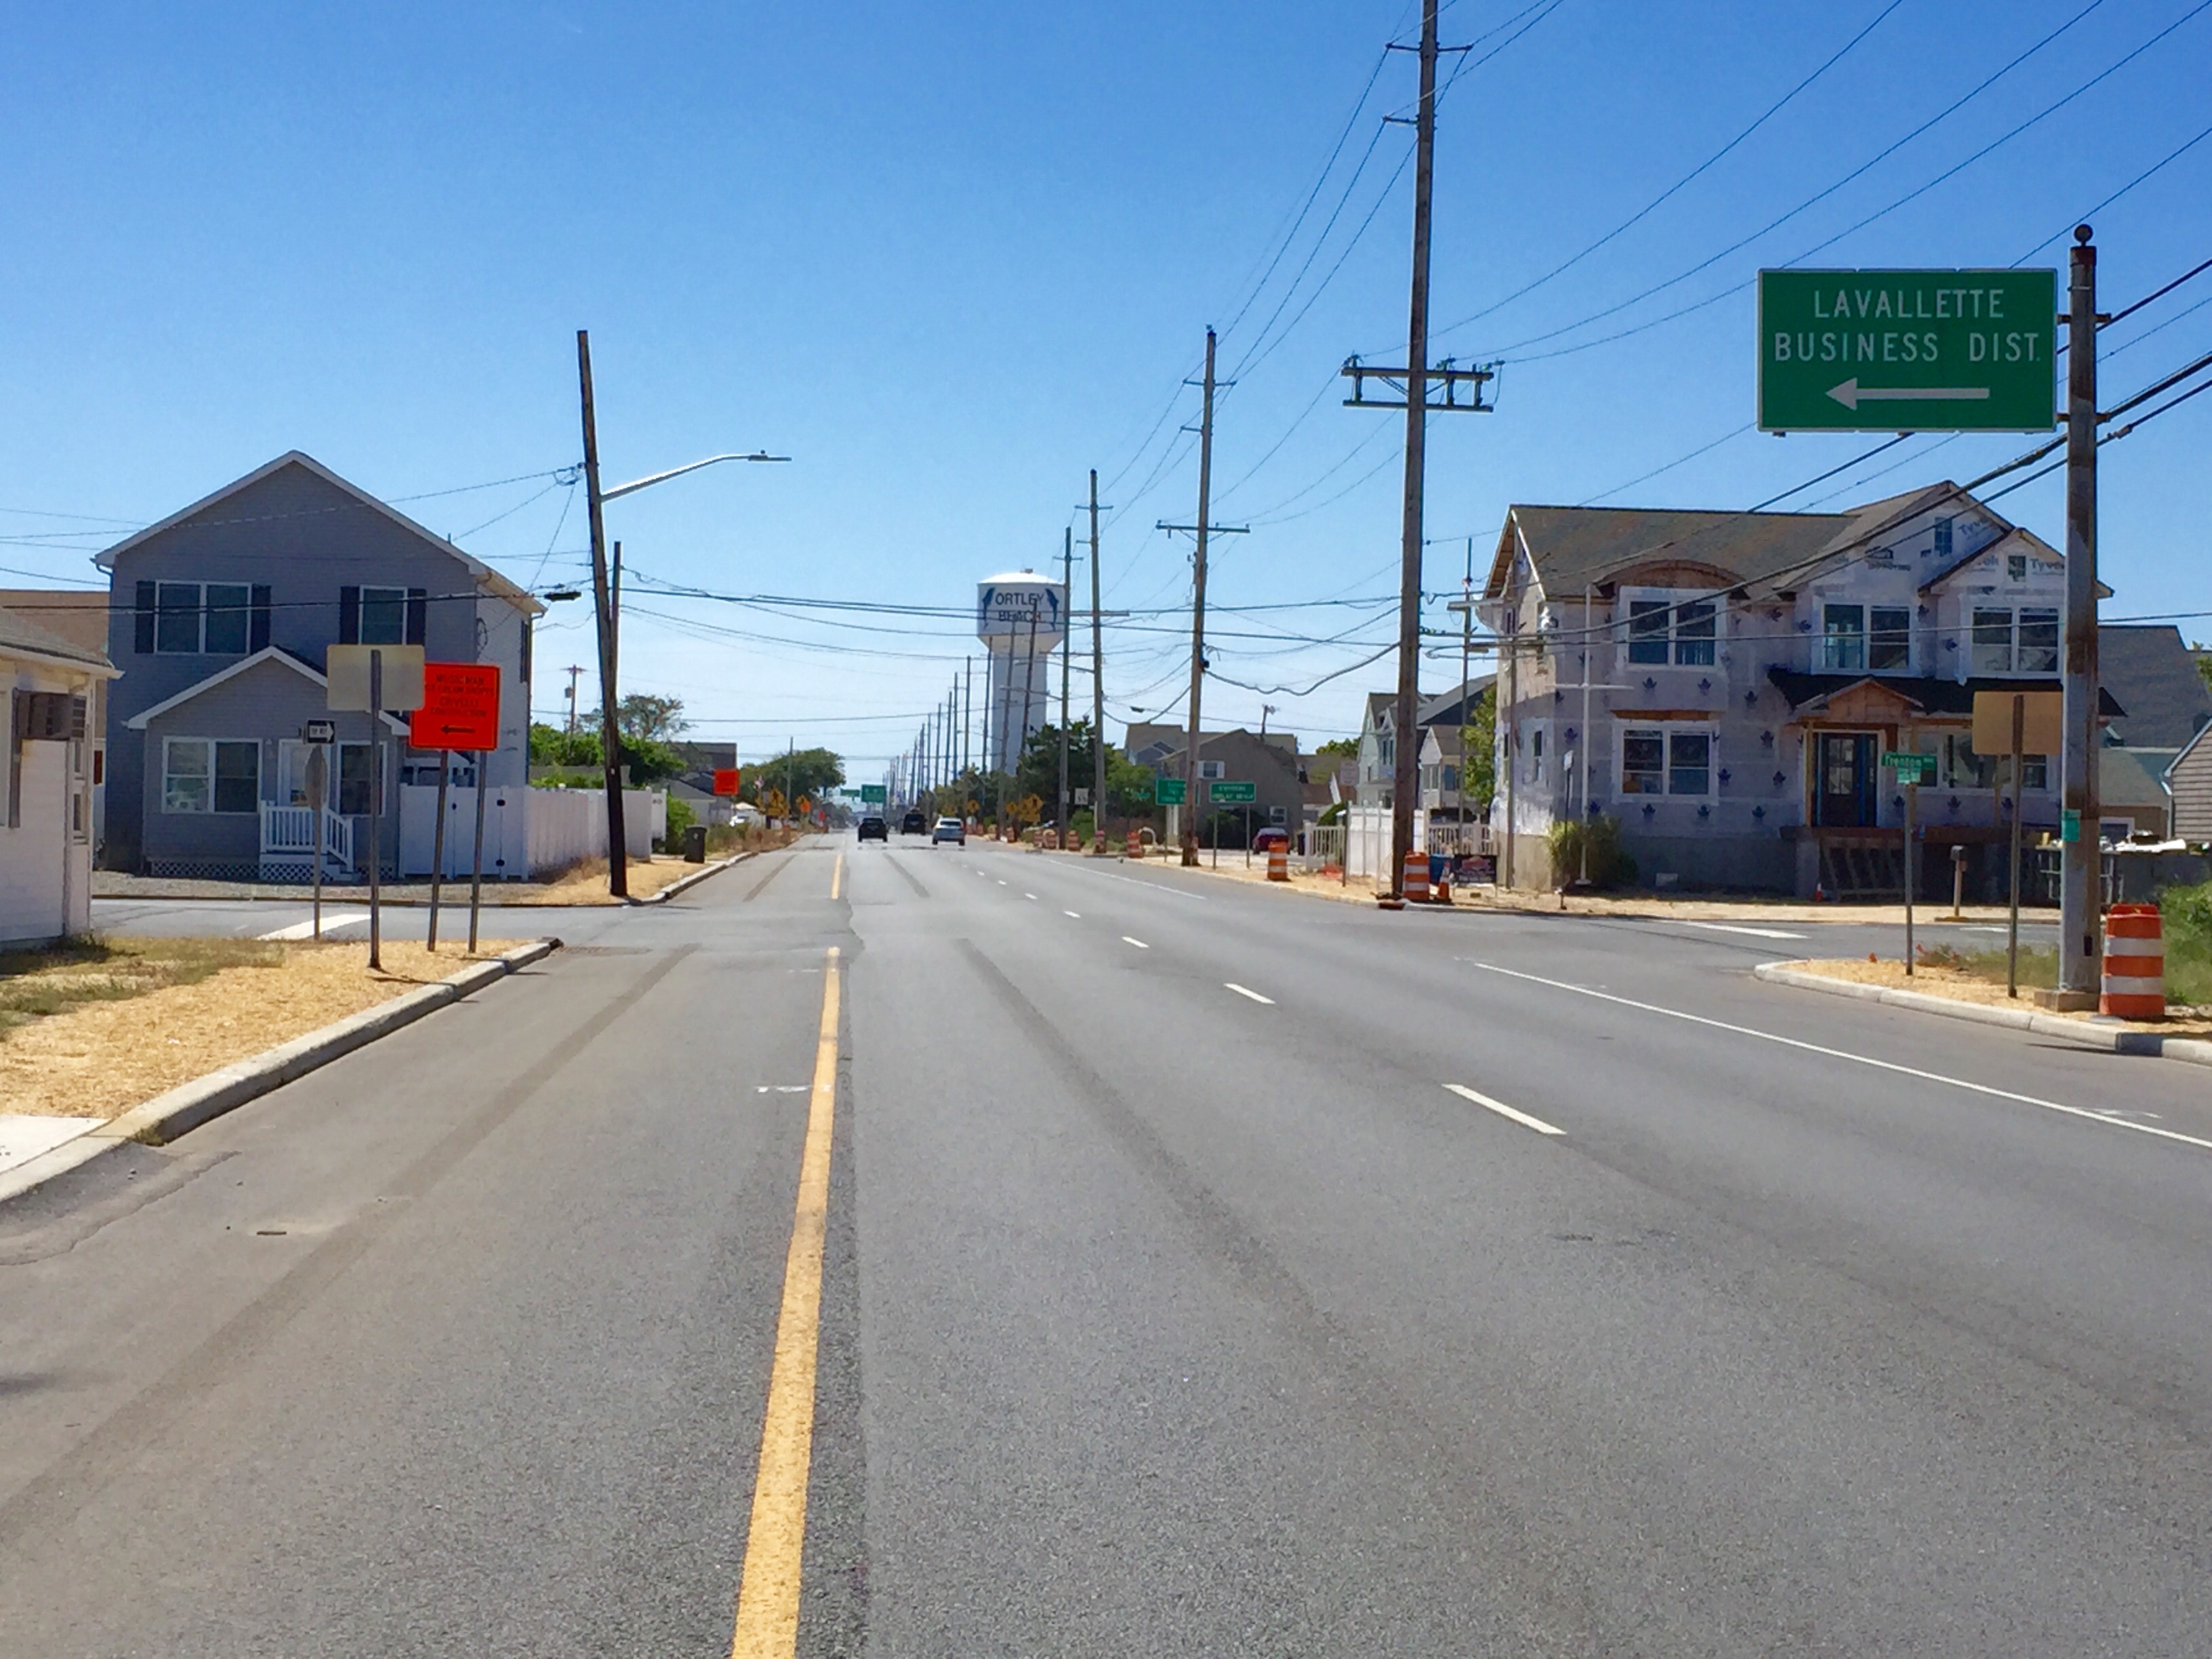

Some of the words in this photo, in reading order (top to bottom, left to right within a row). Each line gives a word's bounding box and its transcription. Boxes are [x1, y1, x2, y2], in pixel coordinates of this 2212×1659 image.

[1814, 289, 2005, 319] LAVALLETTE
[1774, 332, 1939, 362] BUSINESS
[1969, 332, 2041, 362] DIST.
[995, 592, 1043, 605] ORTLEY
